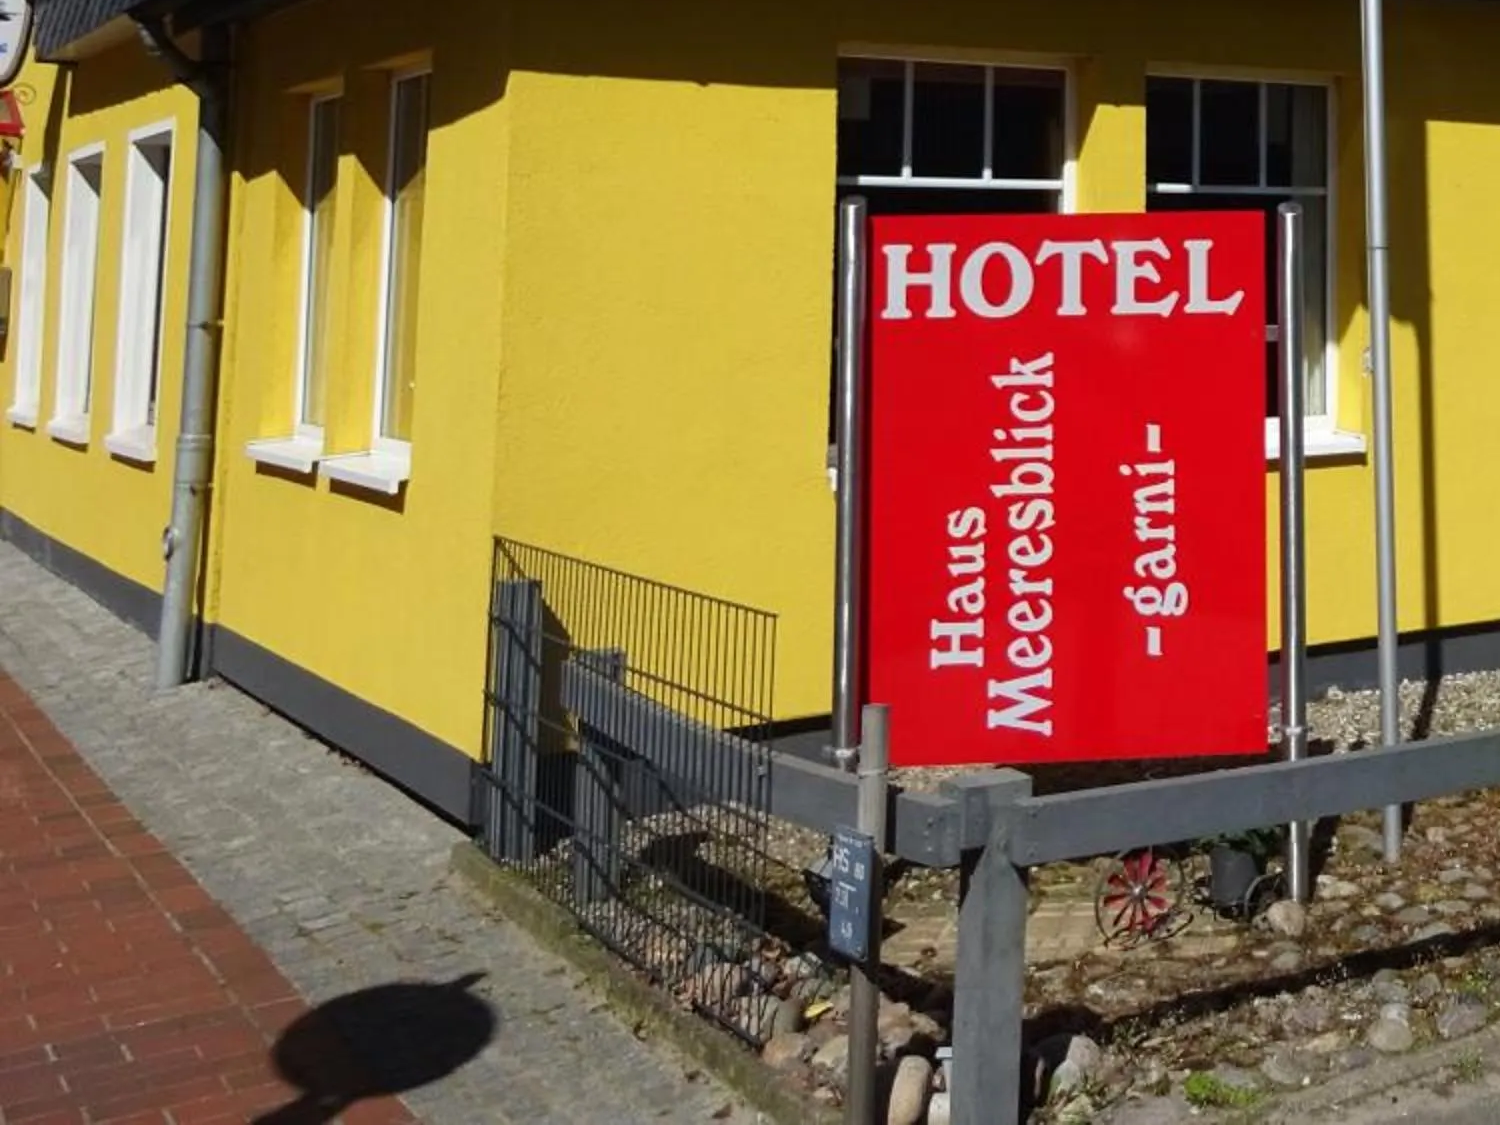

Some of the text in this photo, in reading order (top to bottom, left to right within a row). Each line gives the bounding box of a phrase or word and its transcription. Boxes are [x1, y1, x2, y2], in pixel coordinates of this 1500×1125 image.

[880, 238, 1245, 320] HOTEL
[930, 505, 987, 670] Haus
[987, 351, 1056, 738] Meeresblick
